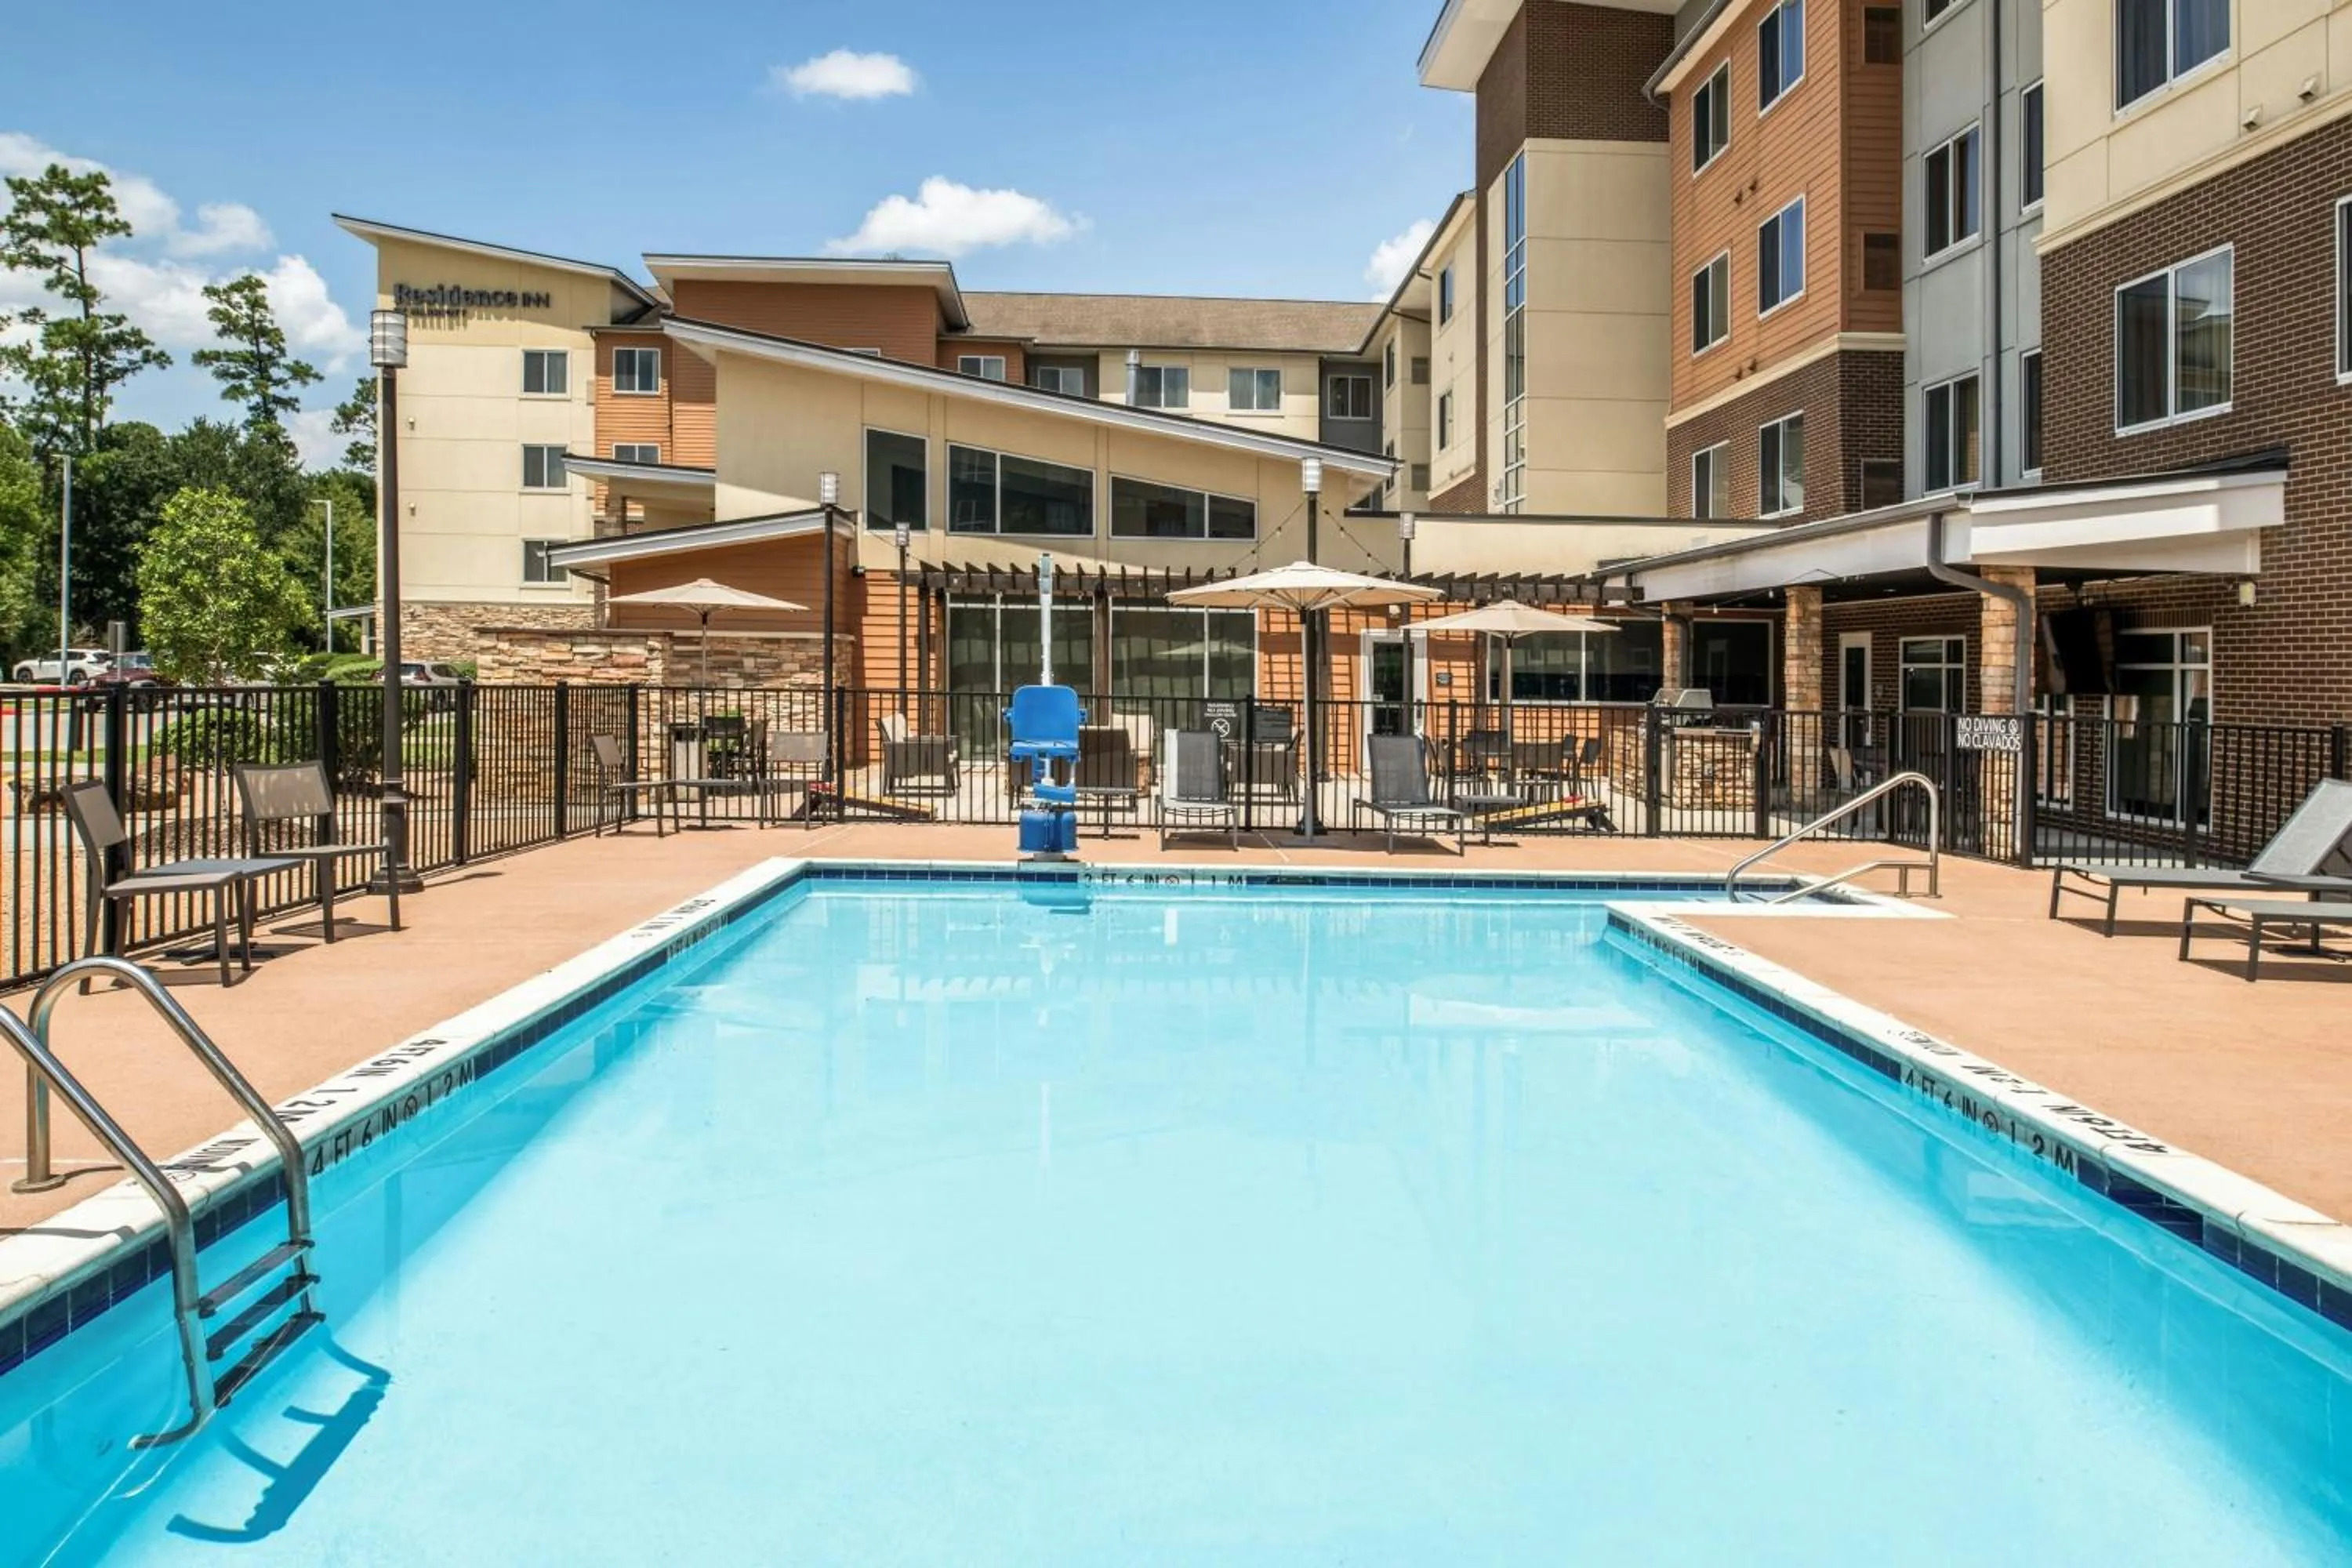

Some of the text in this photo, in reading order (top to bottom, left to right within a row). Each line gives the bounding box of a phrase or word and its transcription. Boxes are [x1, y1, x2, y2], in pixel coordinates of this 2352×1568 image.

[1957, 717, 2006, 733] NO DIVING
[1957, 733, 2021, 750] NO CLAVADOS
[311, 1145, 325, 1176] 4
[334, 1129, 352, 1164] FT
[361, 1120, 372, 1149] 6
[382, 1103, 397, 1135] IN
[1962, 1095, 1977, 1123] IN
[2032, 1133, 2045, 1160] 2
[2055, 1144, 2074, 1176] M
